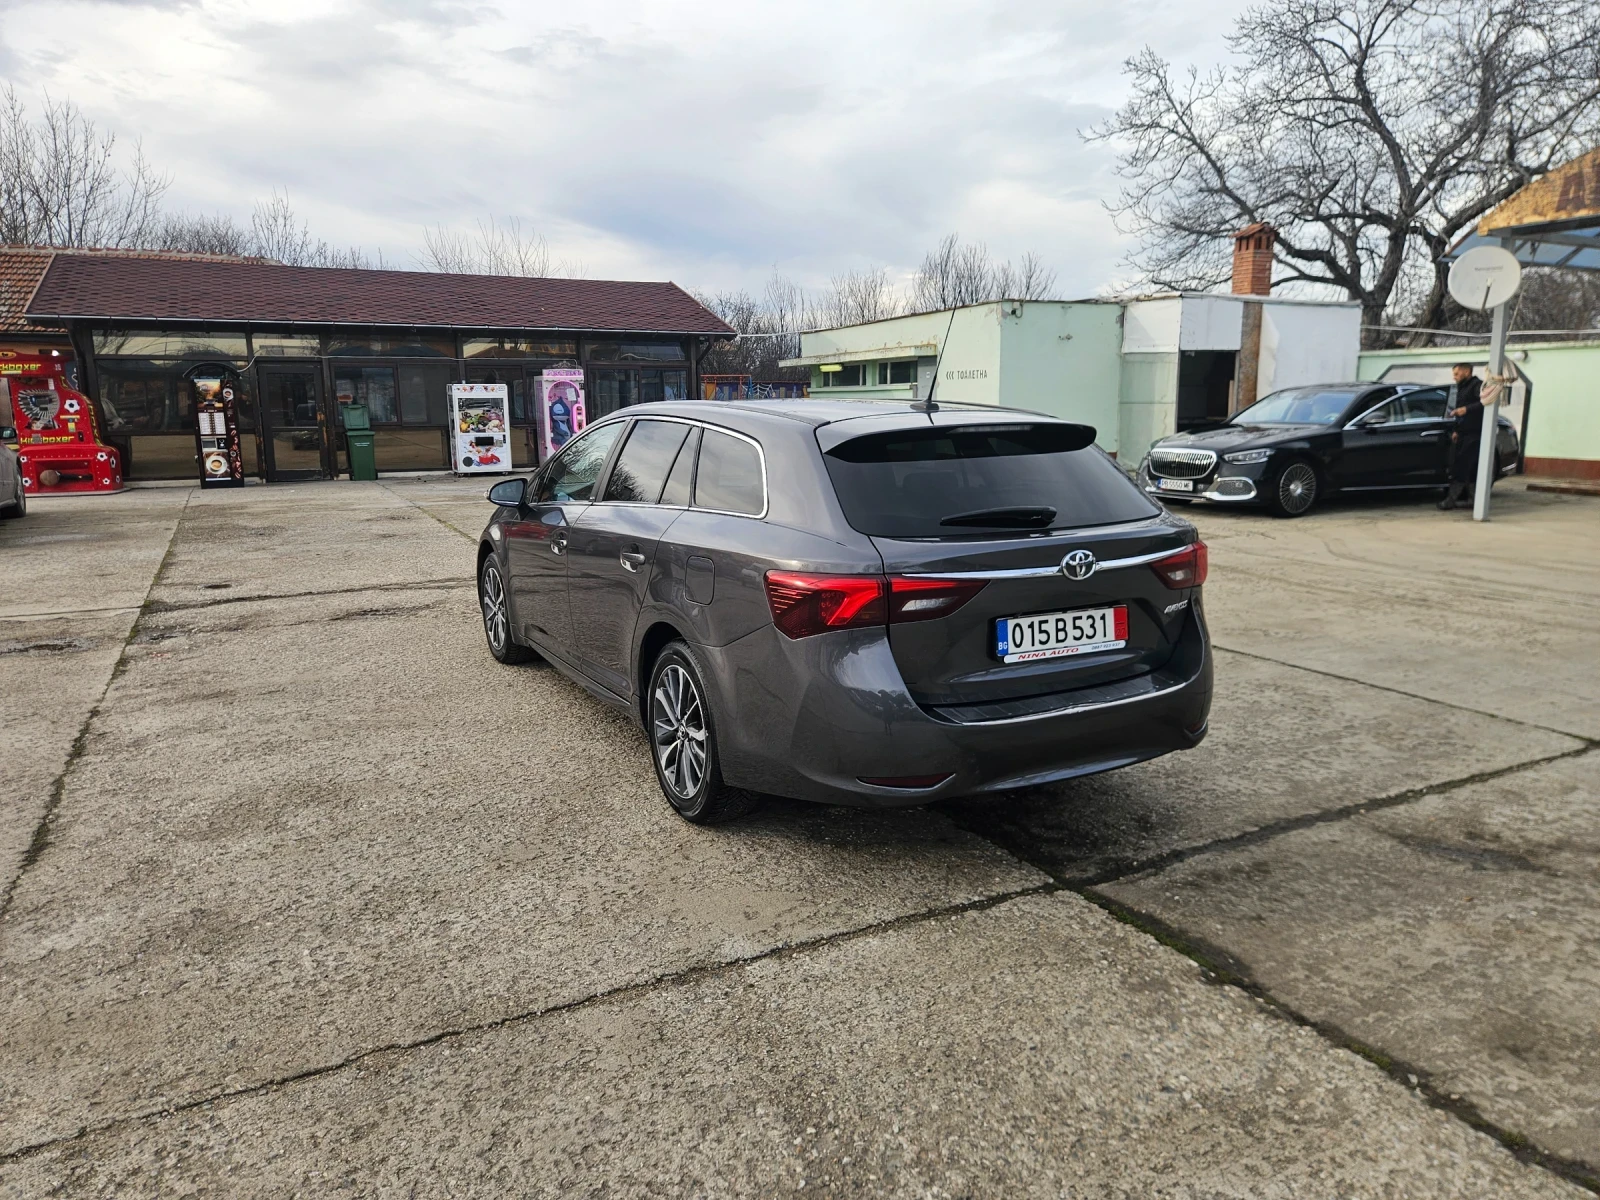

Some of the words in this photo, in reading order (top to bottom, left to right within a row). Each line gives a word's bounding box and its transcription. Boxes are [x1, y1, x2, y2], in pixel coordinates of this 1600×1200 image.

[957, 369, 988, 379] ТОАЛЕТНА
[1012, 613, 1107, 649] 015B531
[998, 642, 1008, 651] BG
[1018, 652, 1046, 660] NINA
[1049, 647, 1079, 656] AUTO
